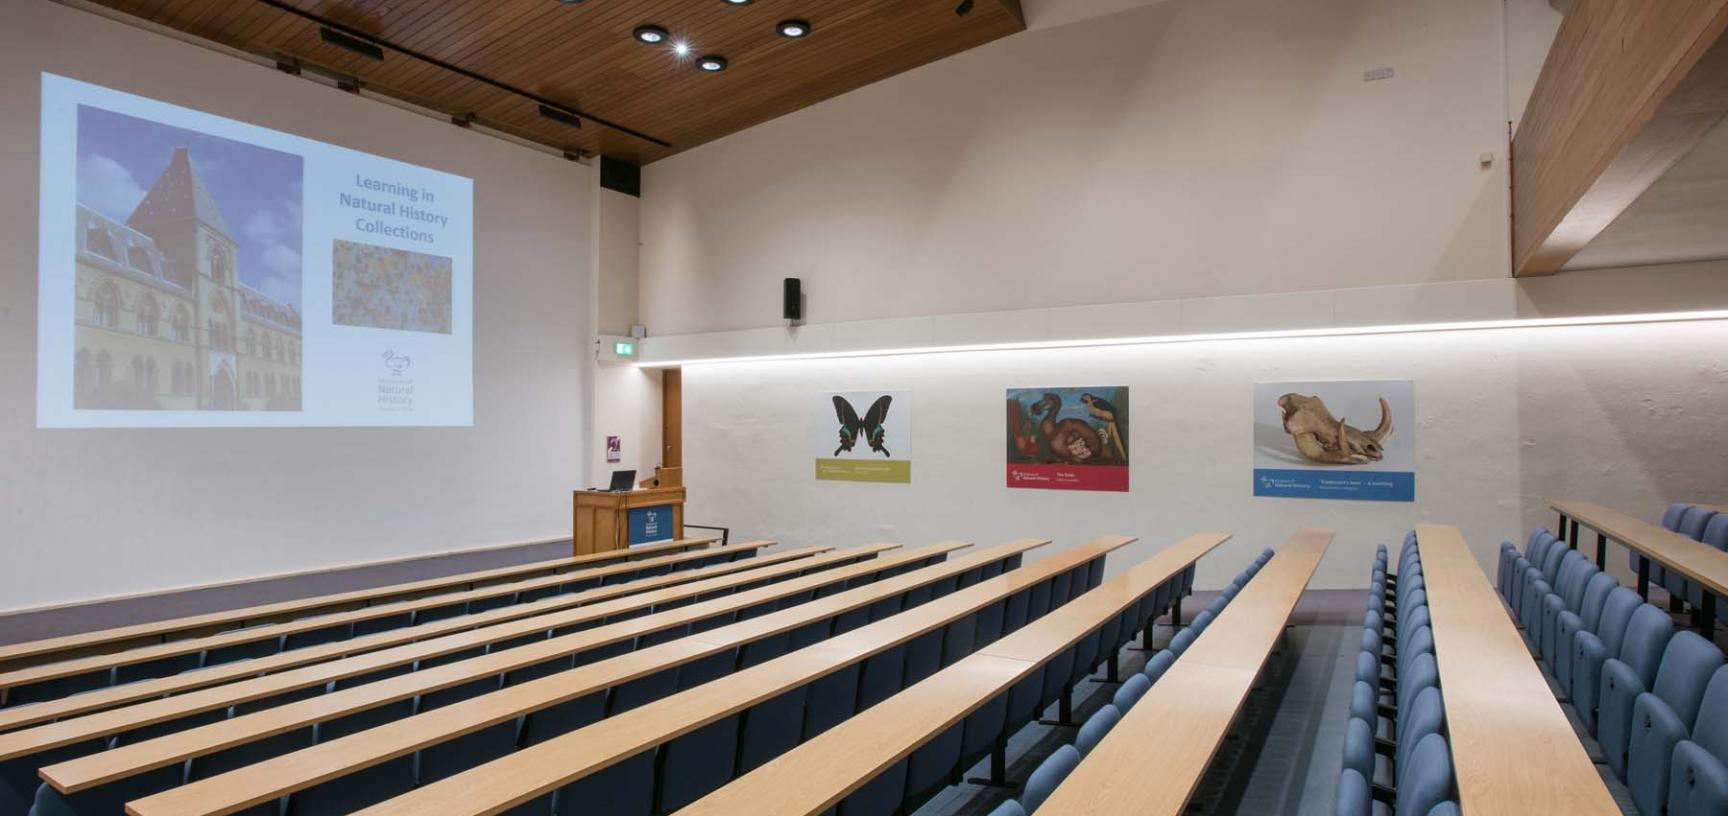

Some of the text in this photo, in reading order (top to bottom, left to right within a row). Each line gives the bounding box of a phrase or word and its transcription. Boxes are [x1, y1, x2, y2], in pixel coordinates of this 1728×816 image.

[355, 173, 435, 203] Learning in
[339, 192, 449, 228] Natural History
[355, 218, 435, 243] Collections
[377, 394, 413, 406] History
[378, 384, 413, 394] Natural
